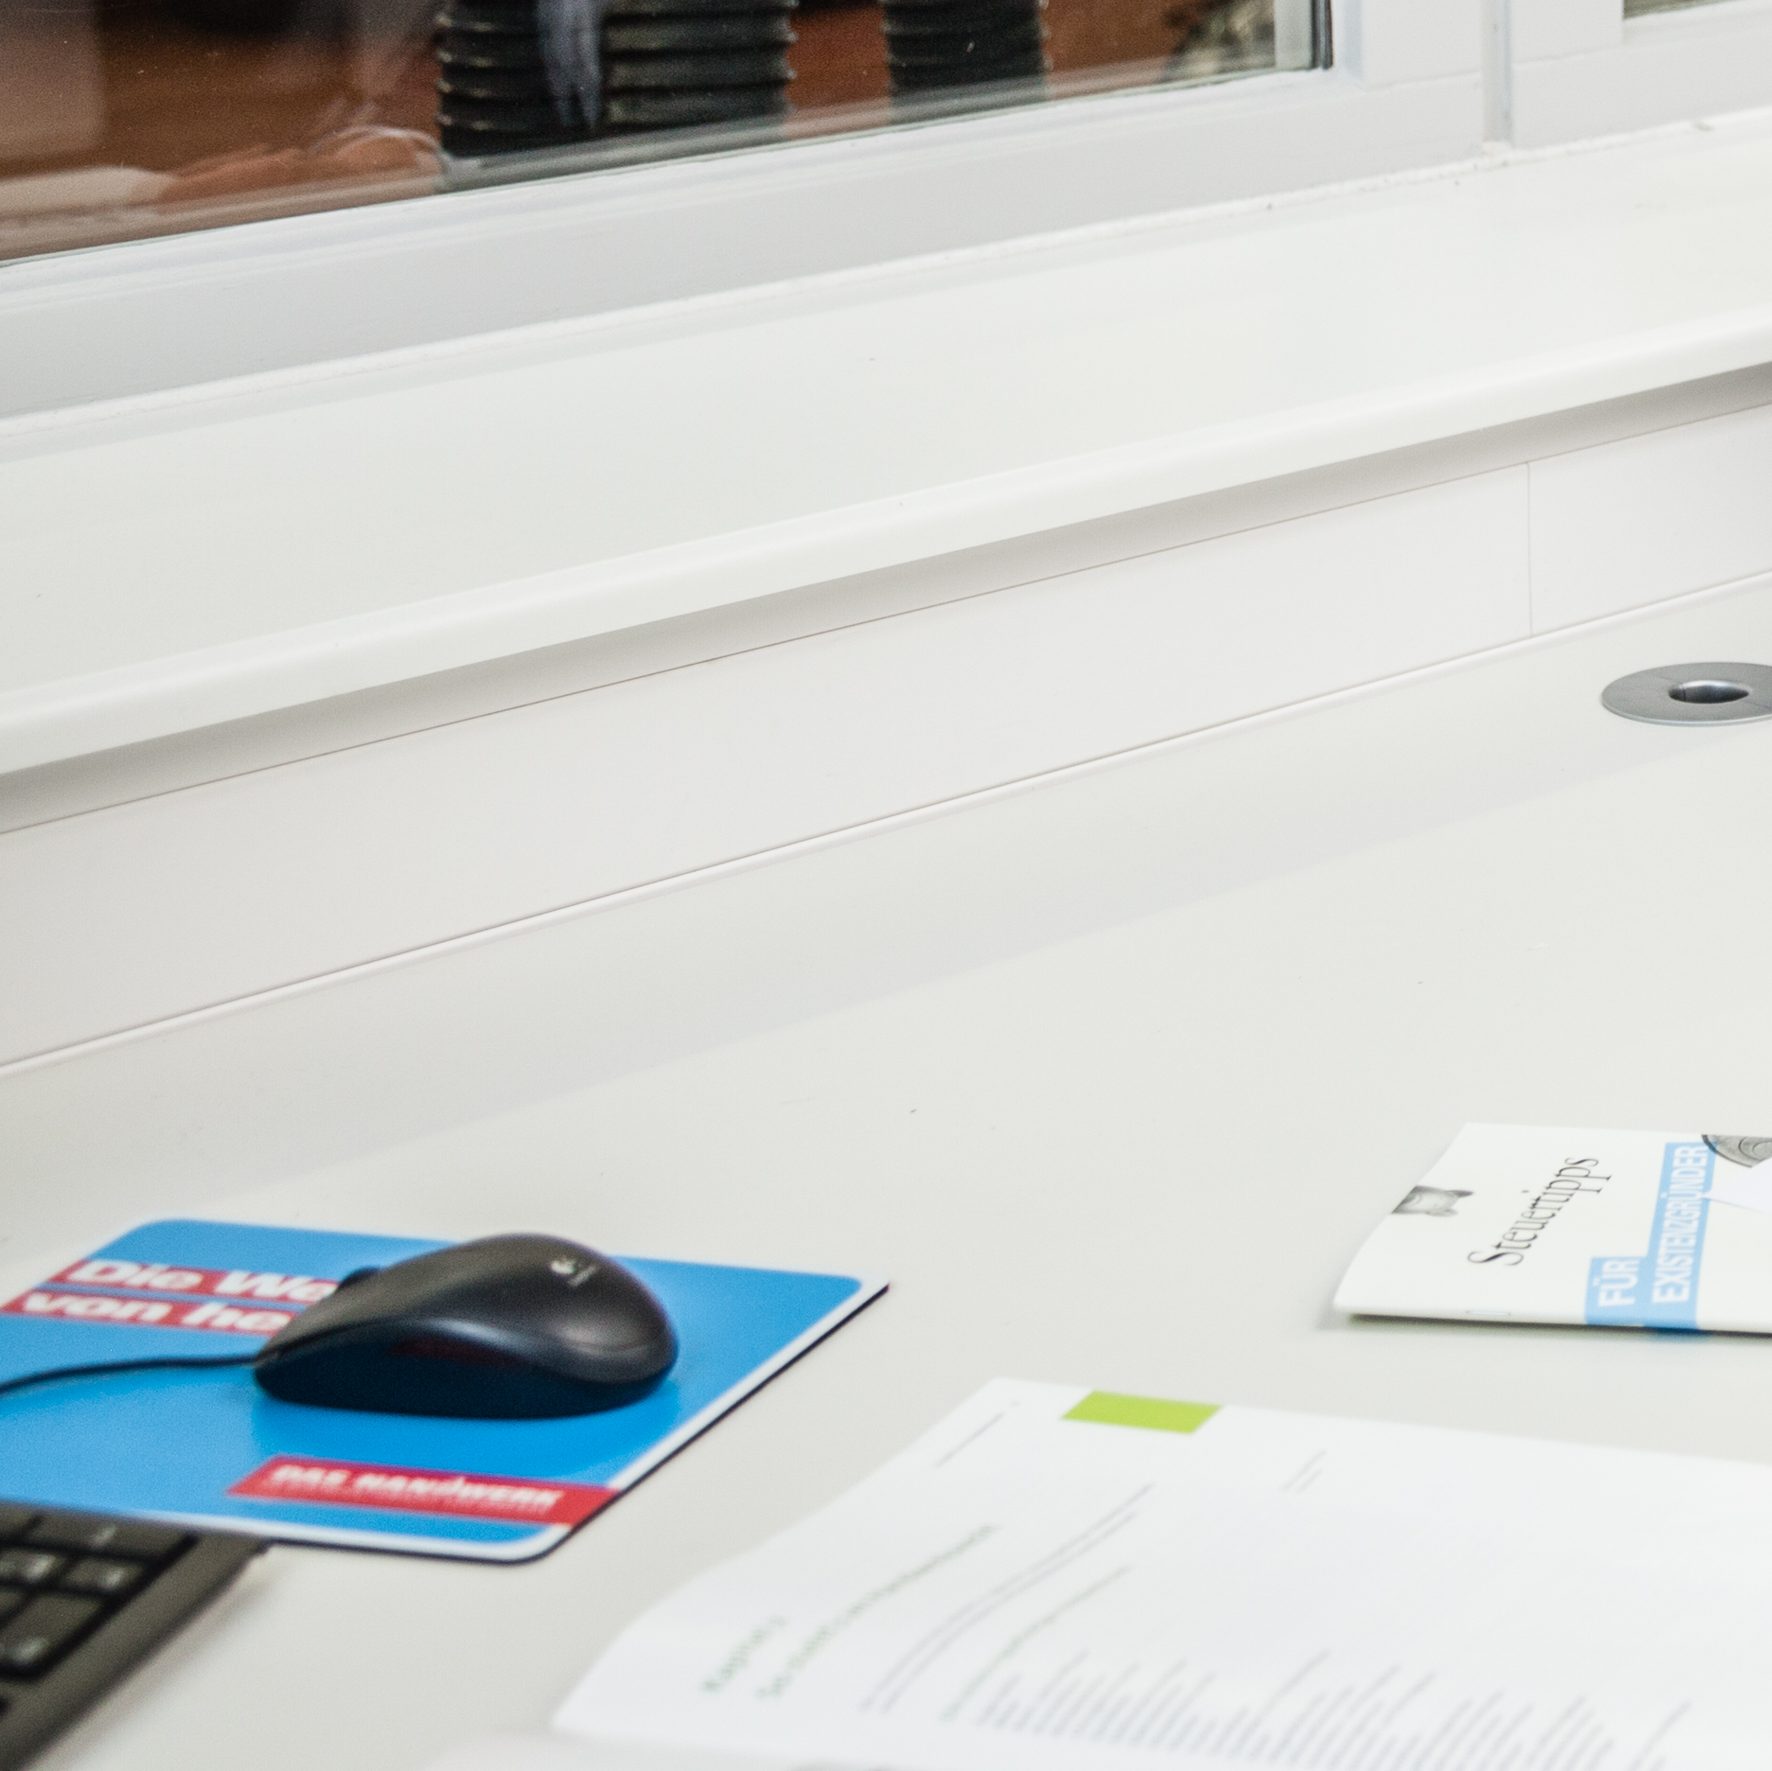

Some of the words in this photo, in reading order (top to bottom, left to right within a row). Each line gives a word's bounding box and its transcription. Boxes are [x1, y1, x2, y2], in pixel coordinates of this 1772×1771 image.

[1467, 1156, 1613, 1266] Steuertipps
[1652, 1145, 1710, 1304] EXISTENZGRÜNDER
[67, 1258, 204, 1290] Die
[1592, 1258, 1641, 1308] FÜR
[24, 1292, 173, 1322] von
